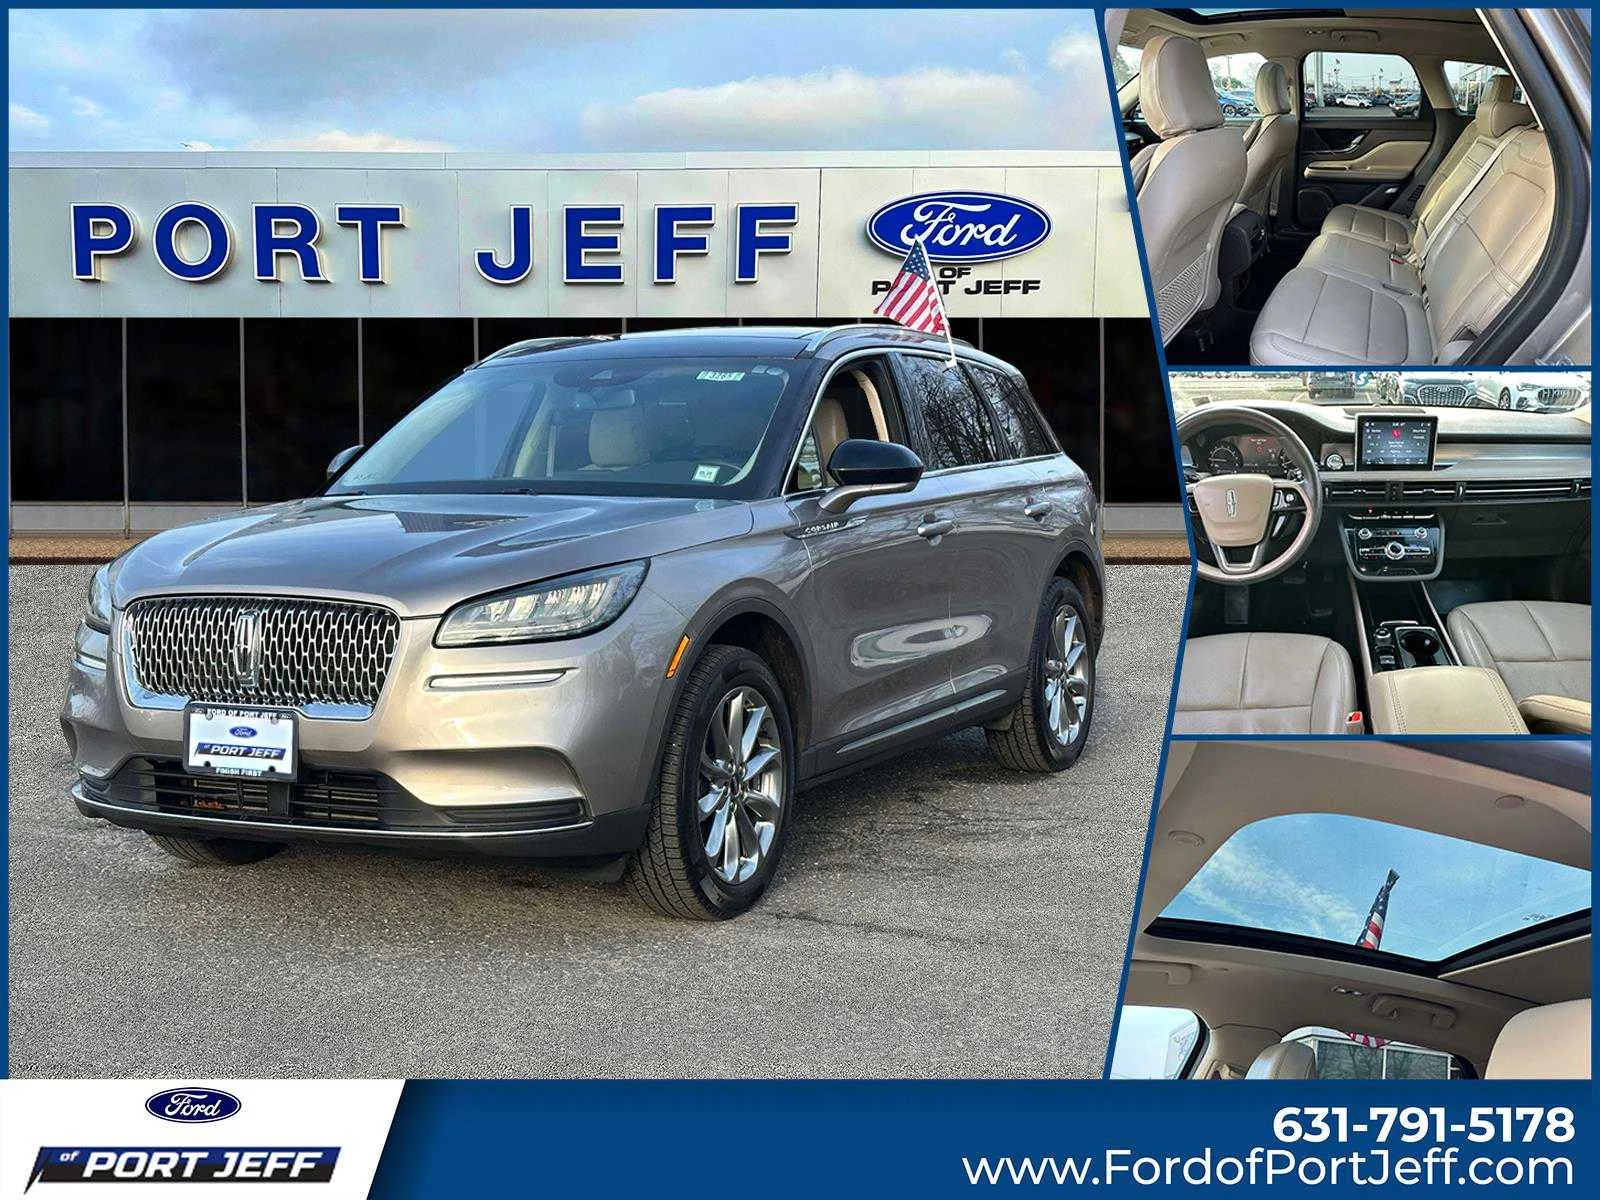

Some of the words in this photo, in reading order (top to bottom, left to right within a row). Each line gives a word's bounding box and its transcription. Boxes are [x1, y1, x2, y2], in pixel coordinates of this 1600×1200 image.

[899, 201, 1022, 248] Ford
[69, 202, 406, 284] PORT
[474, 203, 799, 285] JEFF
[939, 266, 972, 279] OF
[871, 280, 956, 295] PT
[964, 279, 1041, 295] JEFF
[804, 520, 840, 534] CORSAIR
[208, 708, 226, 716] FORD
[228, 709, 238, 717] OF
[240, 710, 260, 719] PORT
[210, 745, 247, 756] PORT
[247, 748, 281, 758] JEFF
